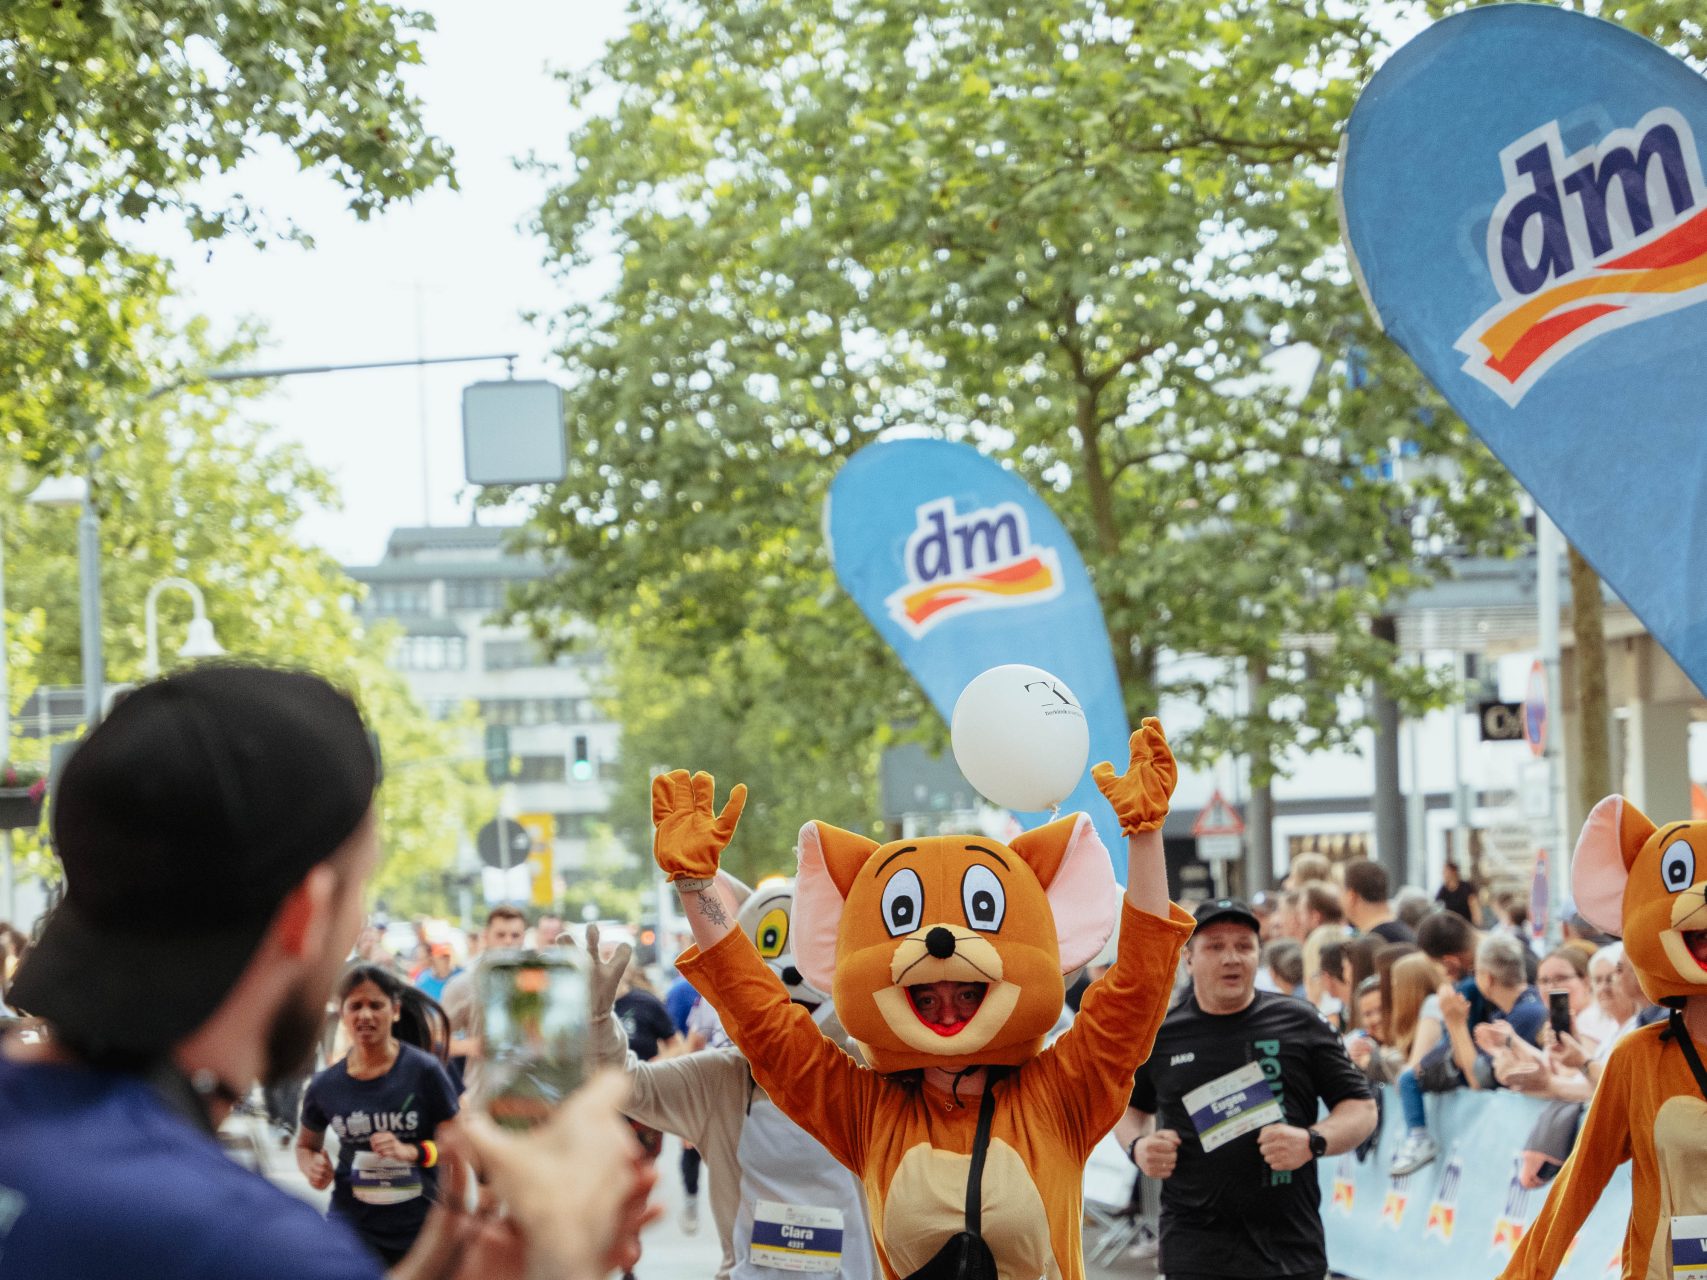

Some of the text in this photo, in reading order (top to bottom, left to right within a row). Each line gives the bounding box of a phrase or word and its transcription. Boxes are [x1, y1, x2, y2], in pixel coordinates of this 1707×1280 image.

[1501, 123, 1696, 295] dm
[914, 509, 1022, 582] dm
[1170, 1051, 1195, 1067] JAKO
[373, 1110, 418, 1131] UKS
[780, 1224, 815, 1240] Clara
